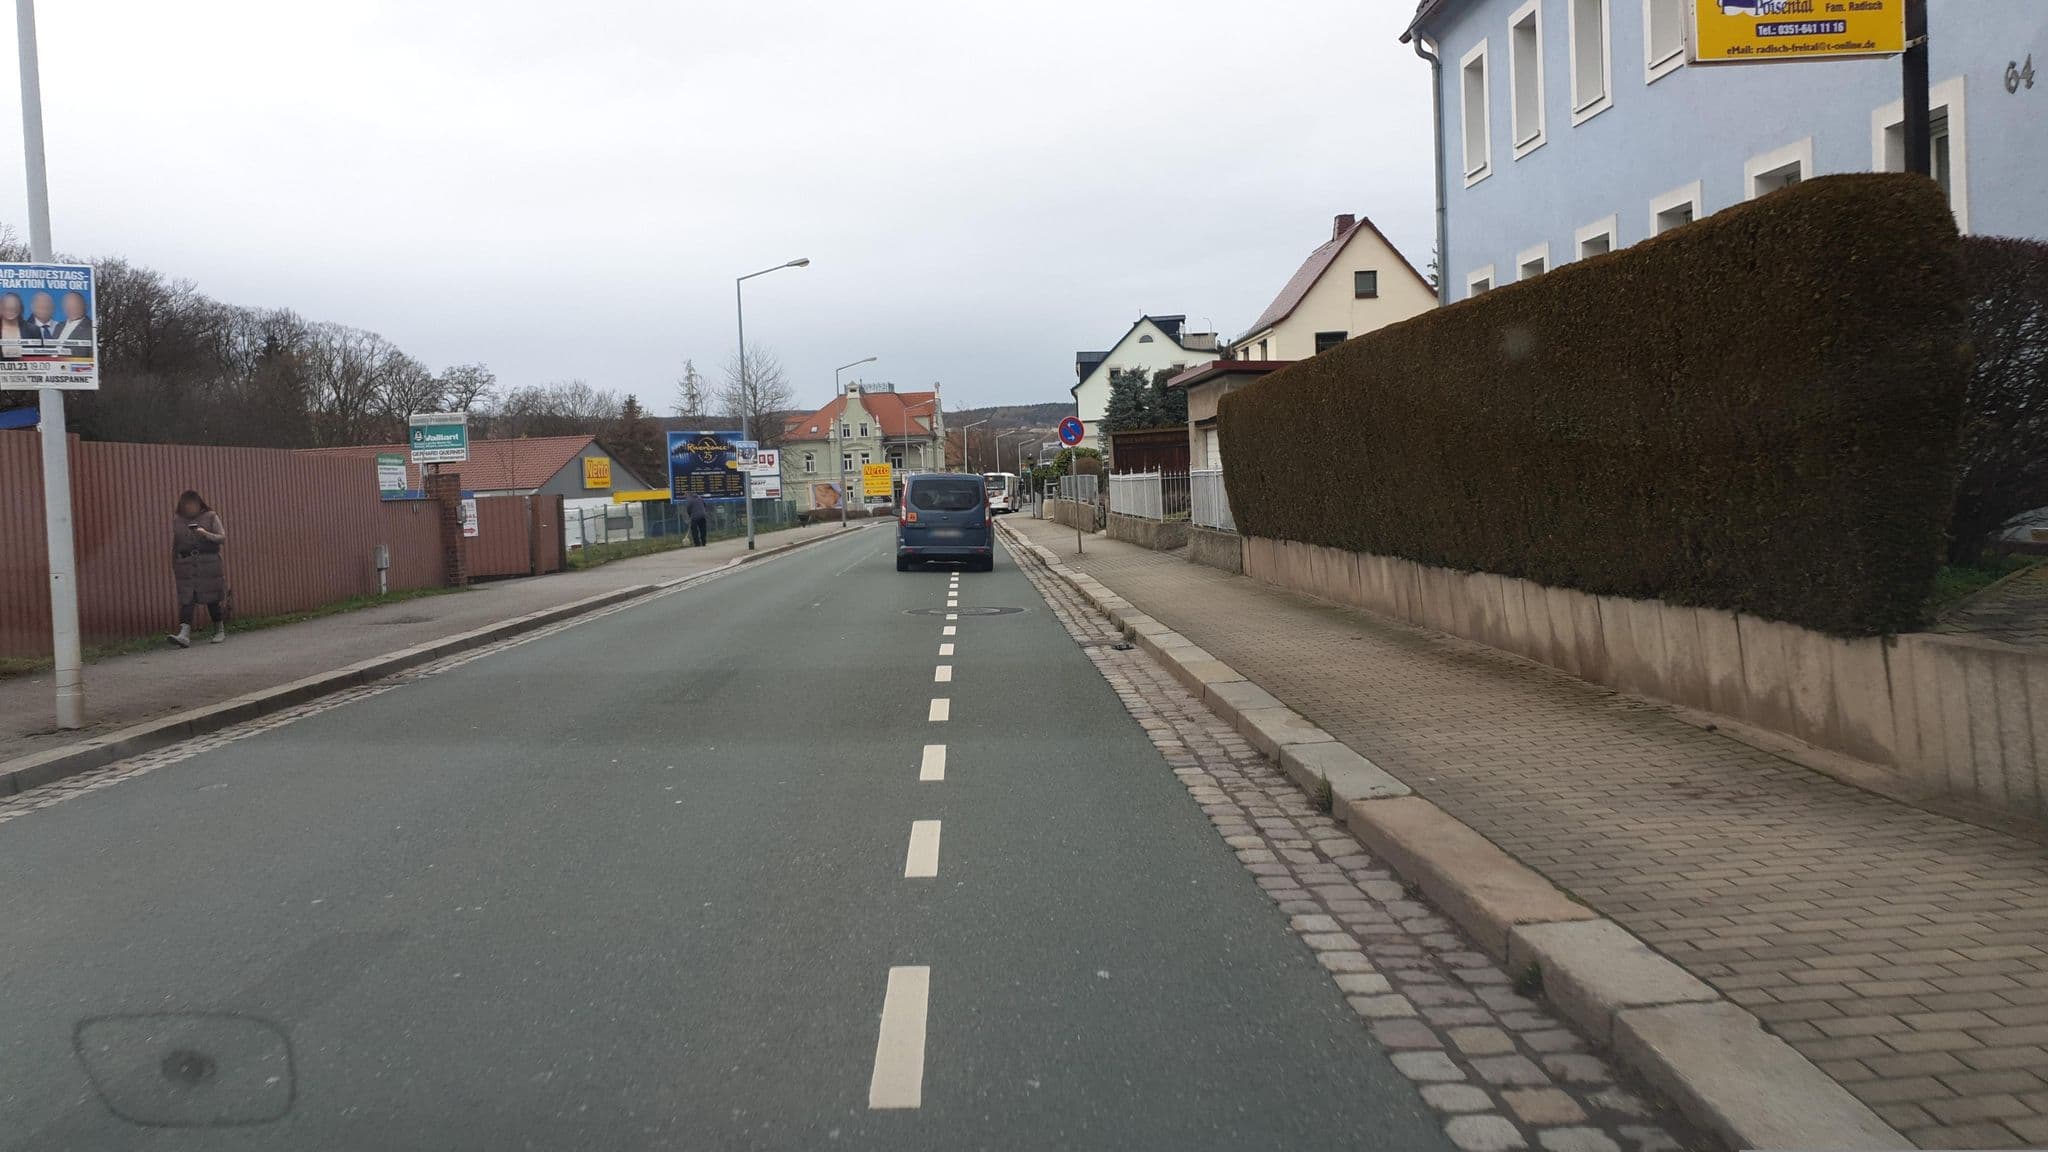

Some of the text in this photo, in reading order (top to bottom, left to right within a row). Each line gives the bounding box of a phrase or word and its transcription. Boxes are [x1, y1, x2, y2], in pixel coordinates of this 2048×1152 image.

[1825, 1, 1883, 13] Fam. Radisch
[1820, 22, 1832, 34] 11
[1833, 21, 1845, 34] 16
[2004, 53, 2036, 95] 64
[47, 279, 68, 290] VOR
[68, 280, 89, 291] ORT
